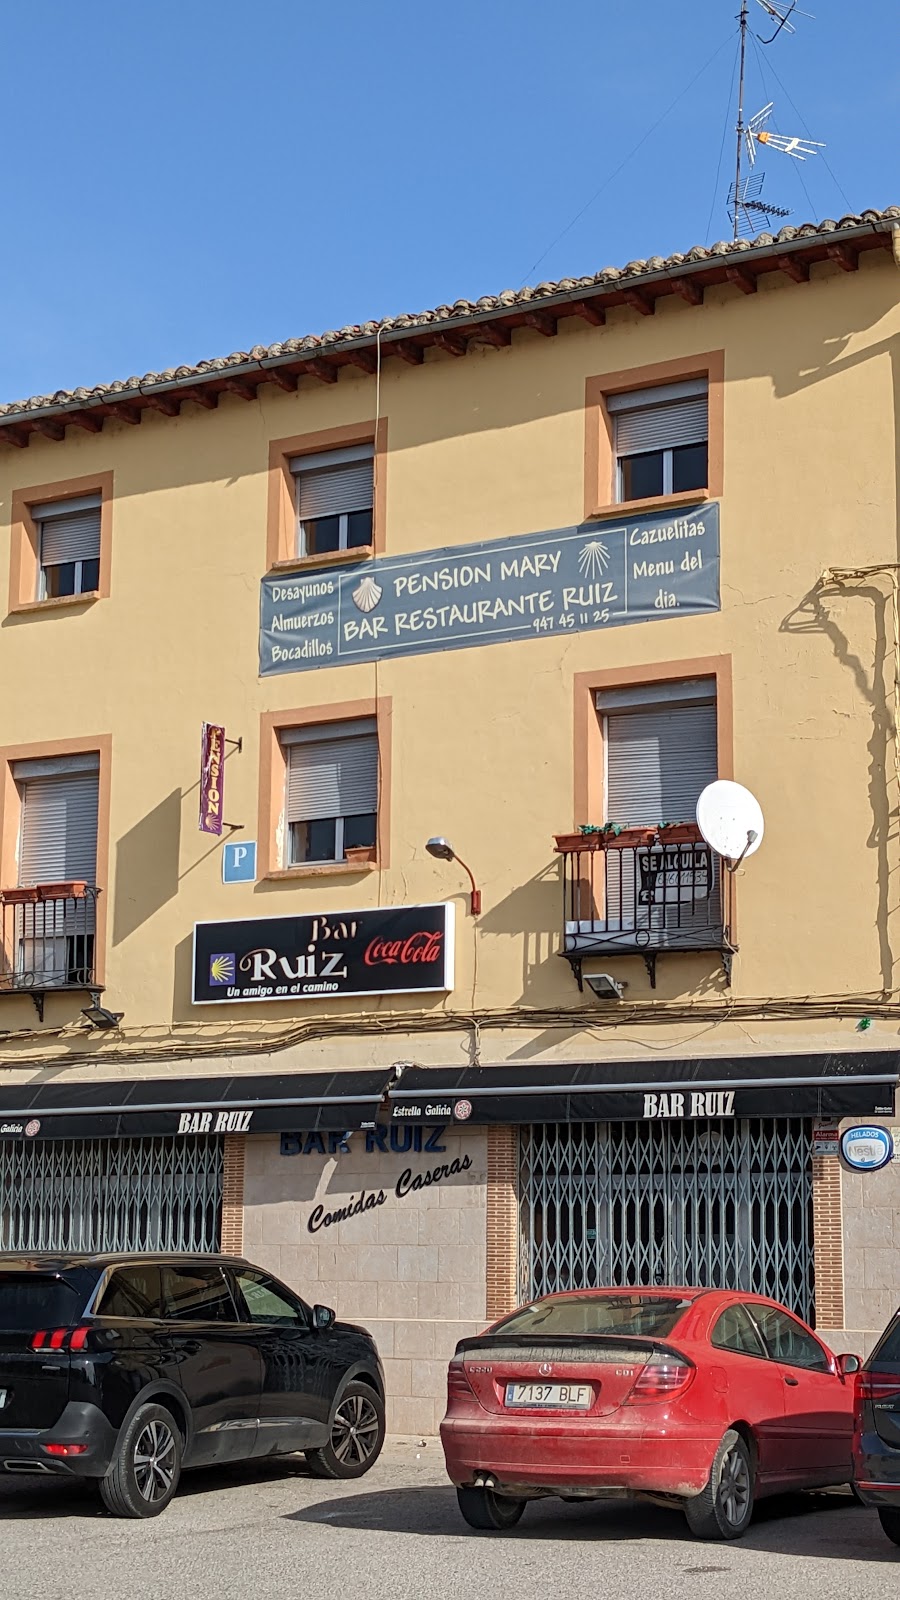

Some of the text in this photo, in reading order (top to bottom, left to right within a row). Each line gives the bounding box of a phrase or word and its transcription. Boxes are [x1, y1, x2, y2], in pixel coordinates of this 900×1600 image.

[629, 519, 706, 546] Cazuelitas
[393, 551, 562, 598] PENSION MARY
[633, 549, 703, 580] Menu del
[271, 580, 334, 605] Desayunos
[271, 610, 334, 632] Almuerzos
[343, 582, 618, 642] BAR RESTAURANTE RUIZ
[532, 608, 610, 632] 947 45 11 25
[271, 638, 333, 663] Bocadillos
[207, 727, 221, 815] PENSION
[233, 846, 247, 868] P
[642, 855, 657, 872] SE
[311, 916, 361, 942] Bar
[364, 931, 444, 966] Coca-Cola
[239, 944, 347, 981] Ruiz
[226, 981, 339, 998] Un amigo en el camino
[392, 1104, 452, 1117] Estrella Galicia
[643, 1091, 735, 1118] BAR RUIZ
[0, 1123, 23, 1133] Galicia
[177, 1110, 253, 1134] BAR RUIZ
[850, 1130, 879, 1139] HELADOS
[280, 1124, 447, 1156] BAR RUIZ
[307, 1154, 473, 1234] Comidas Caseras
[517, 1385, 587, 1402] 7137 BLF
